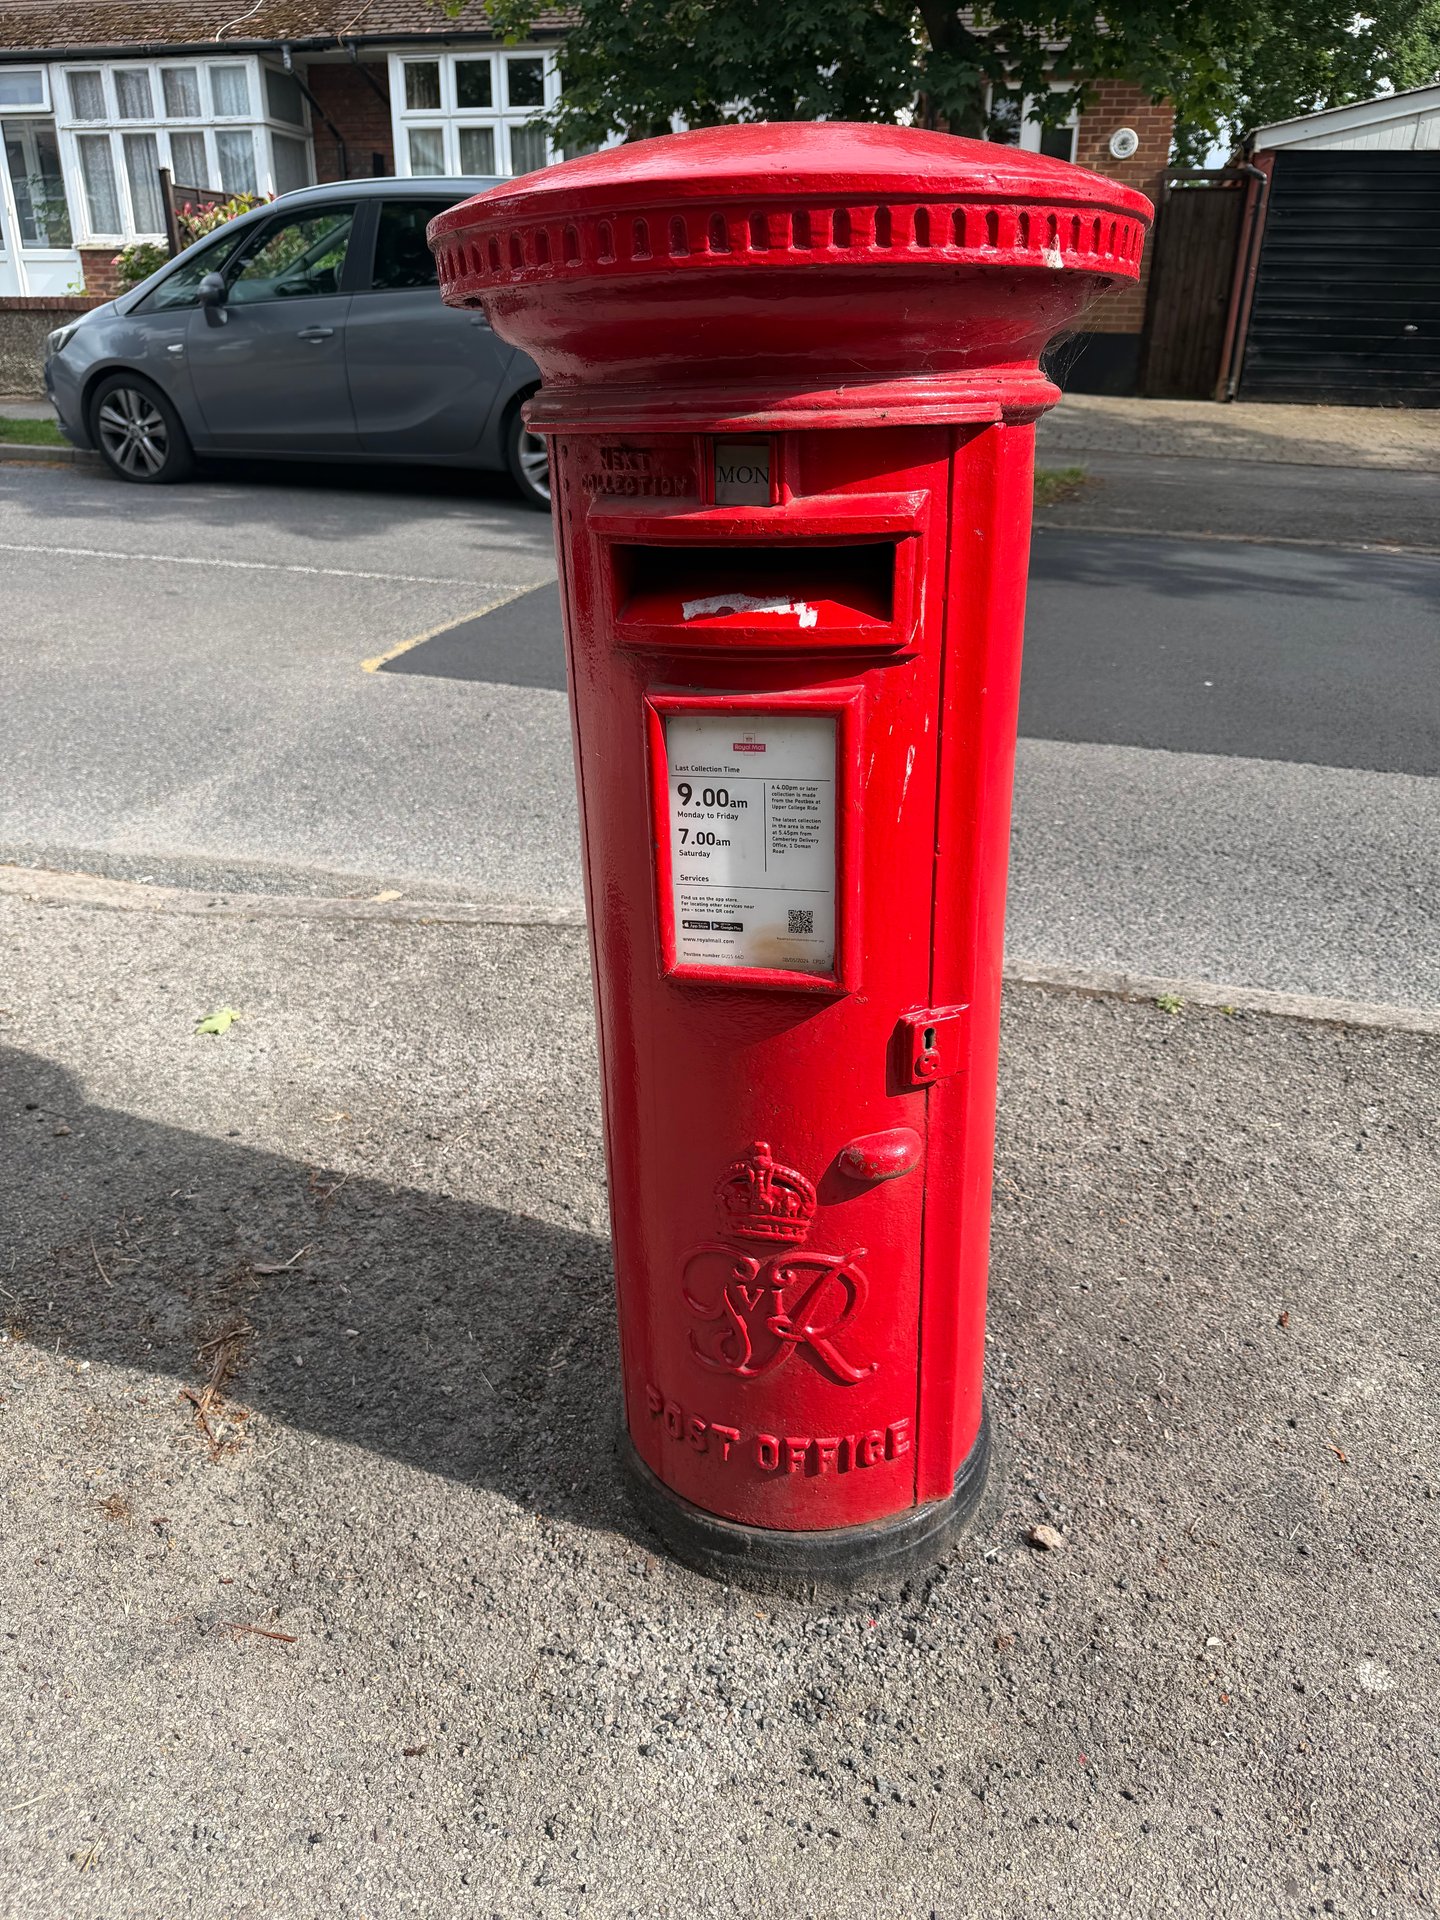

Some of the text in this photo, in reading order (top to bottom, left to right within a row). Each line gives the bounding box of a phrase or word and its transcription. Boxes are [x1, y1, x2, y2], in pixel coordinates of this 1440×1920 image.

[600, 450, 650, 472] NEXT
[718, 466, 769, 484] MON
[677, 783, 748, 808] 9.00am
[678, 811, 705, 820] Monday
[717, 813, 739, 821] Friday
[678, 828, 731, 846] 7.00am
[679, 850, 710, 858] Saturday
[680, 874, 709, 882] Services
[646, 1384, 910, 1476] POST OFFICE
